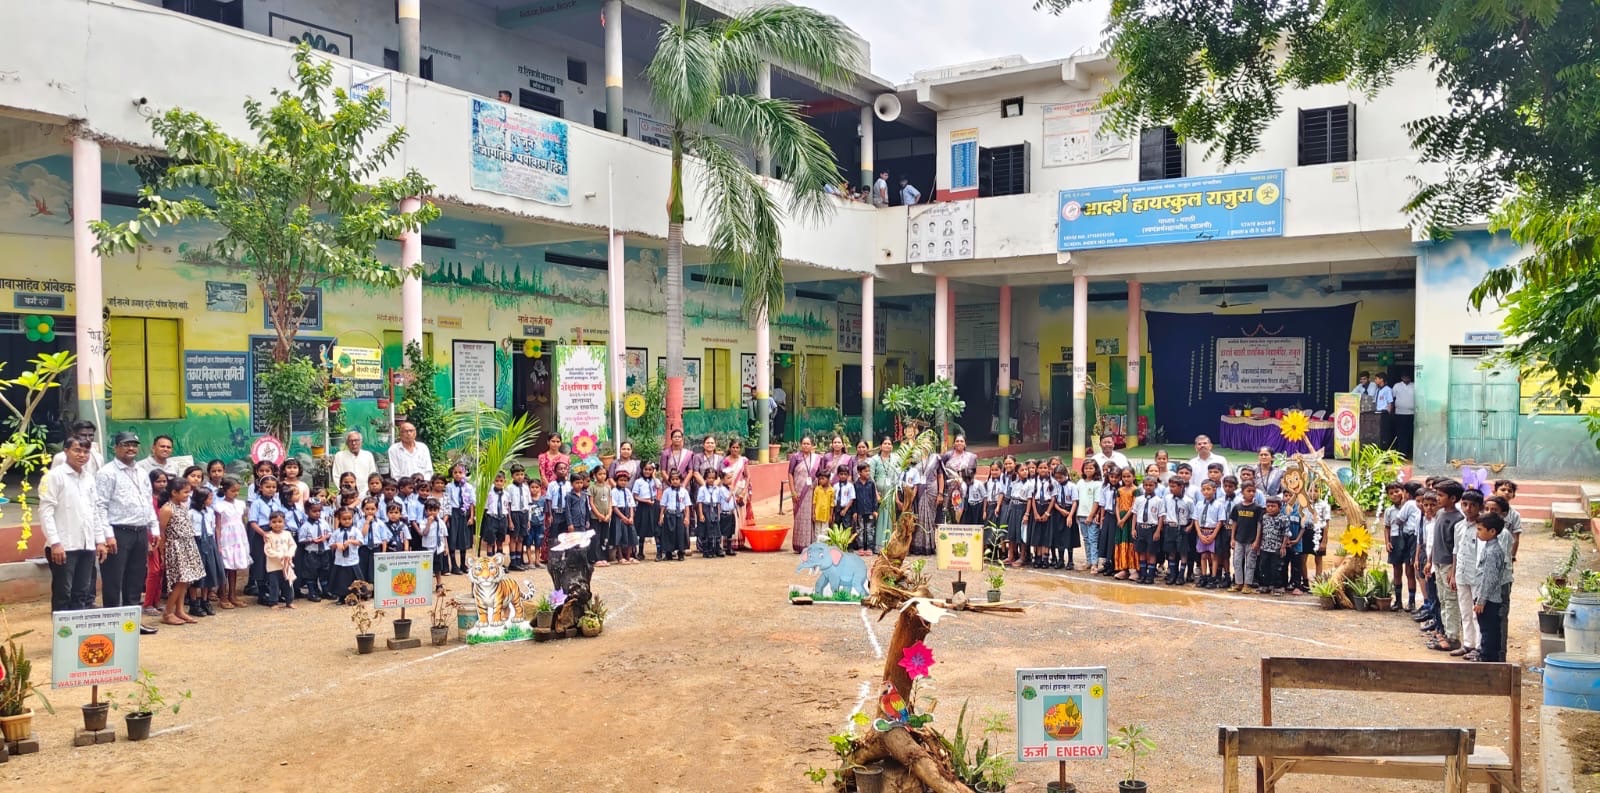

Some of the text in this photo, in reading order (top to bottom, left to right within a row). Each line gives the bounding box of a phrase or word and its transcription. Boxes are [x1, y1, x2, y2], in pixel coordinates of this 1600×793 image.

[1083, 193, 1128, 216] आदर्श
[1205, 187, 1254, 210] राजुरा
[202, 366, 224, 381] निवारण
[224, 366, 244, 381] समिती
[561, 381, 602, 392] शैक्षणिक वर्ष
[58, 675, 132, 688] WASTE MANAGEMENT
[1023, 744, 1104, 758] ऊर्जा ENERGY
